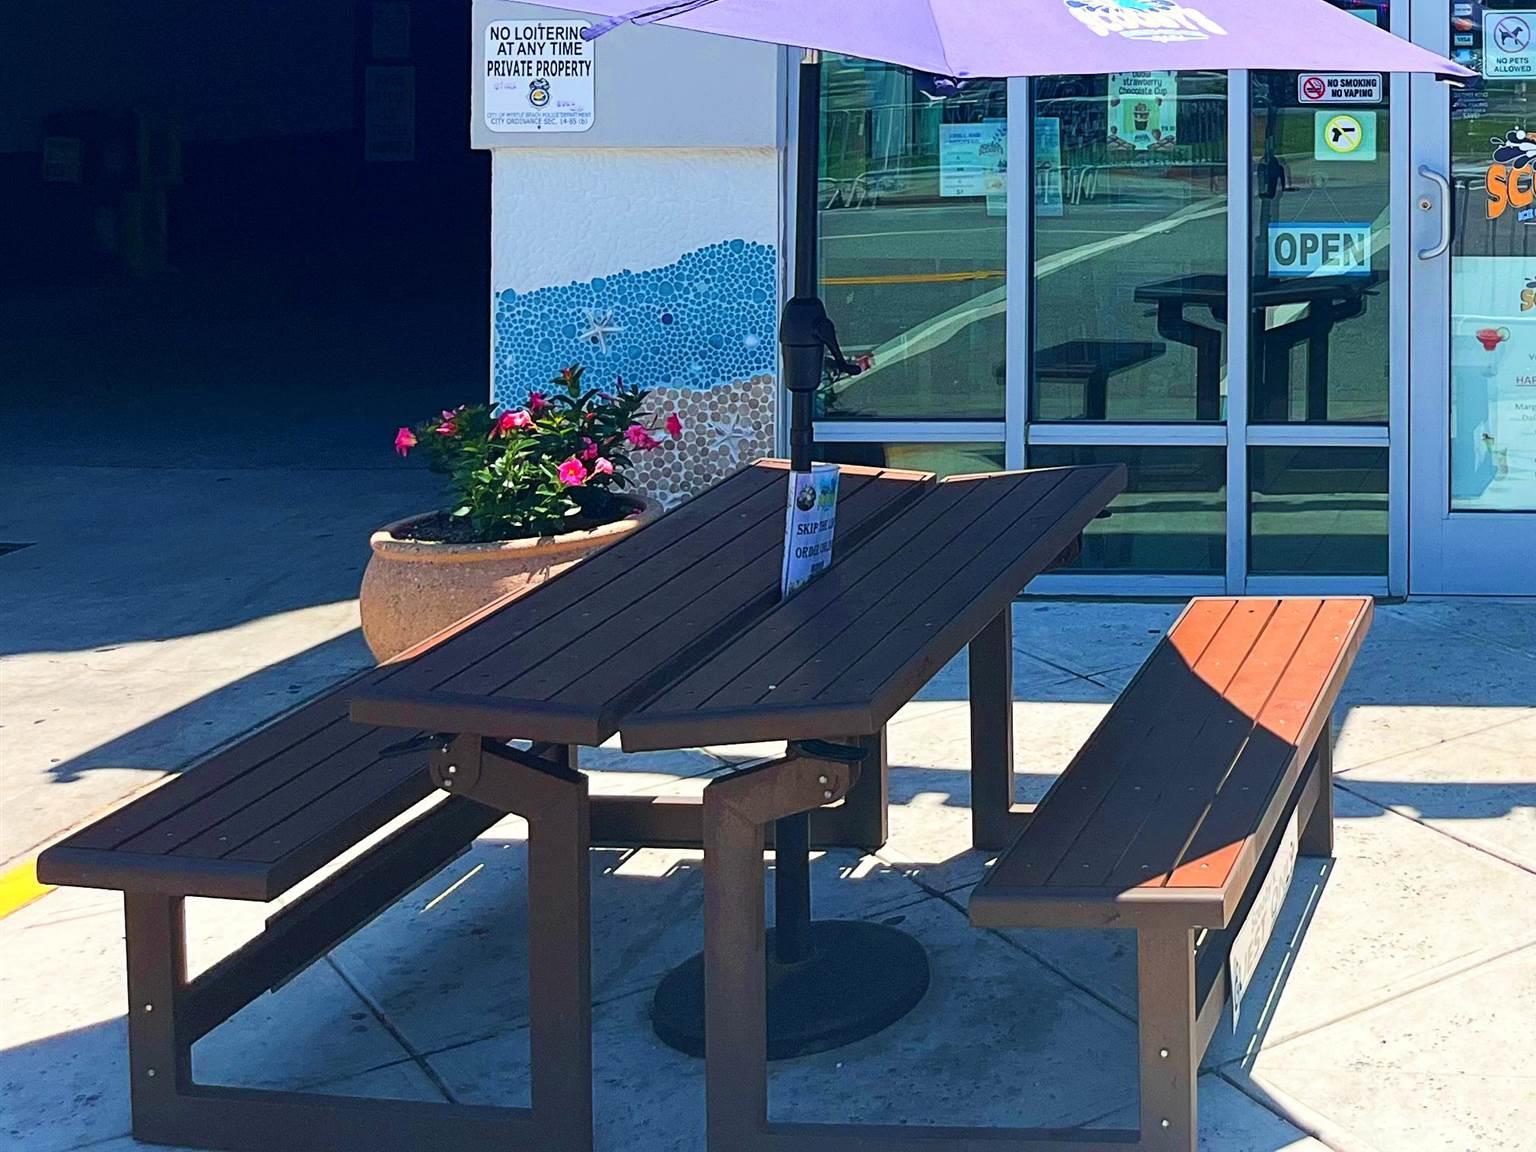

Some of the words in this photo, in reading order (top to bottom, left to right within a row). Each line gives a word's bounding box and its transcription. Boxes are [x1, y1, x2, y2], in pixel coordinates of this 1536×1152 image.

[490, 27, 511, 41] NO
[497, 42, 514, 56] AT
[517, 42, 546, 56] ANY
[550, 42, 583, 56] TIME
[1497, 57, 1508, 65] NO
[1510, 57, 1530, 65] PETS
[487, 60, 533, 77] PRIVATE
[536, 60, 592, 77] PROPERTY
[1494, 65, 1532, 73] ALLOWED
[1327, 79, 1338, 88] NO
[1340, 79, 1377, 88] SMOKING
[1331, 89, 1342, 98] NO
[1343, 89, 1373, 98] VAPING
[1518, 209, 1533, 222] ICE
[1274, 232, 1365, 266] OPEN
